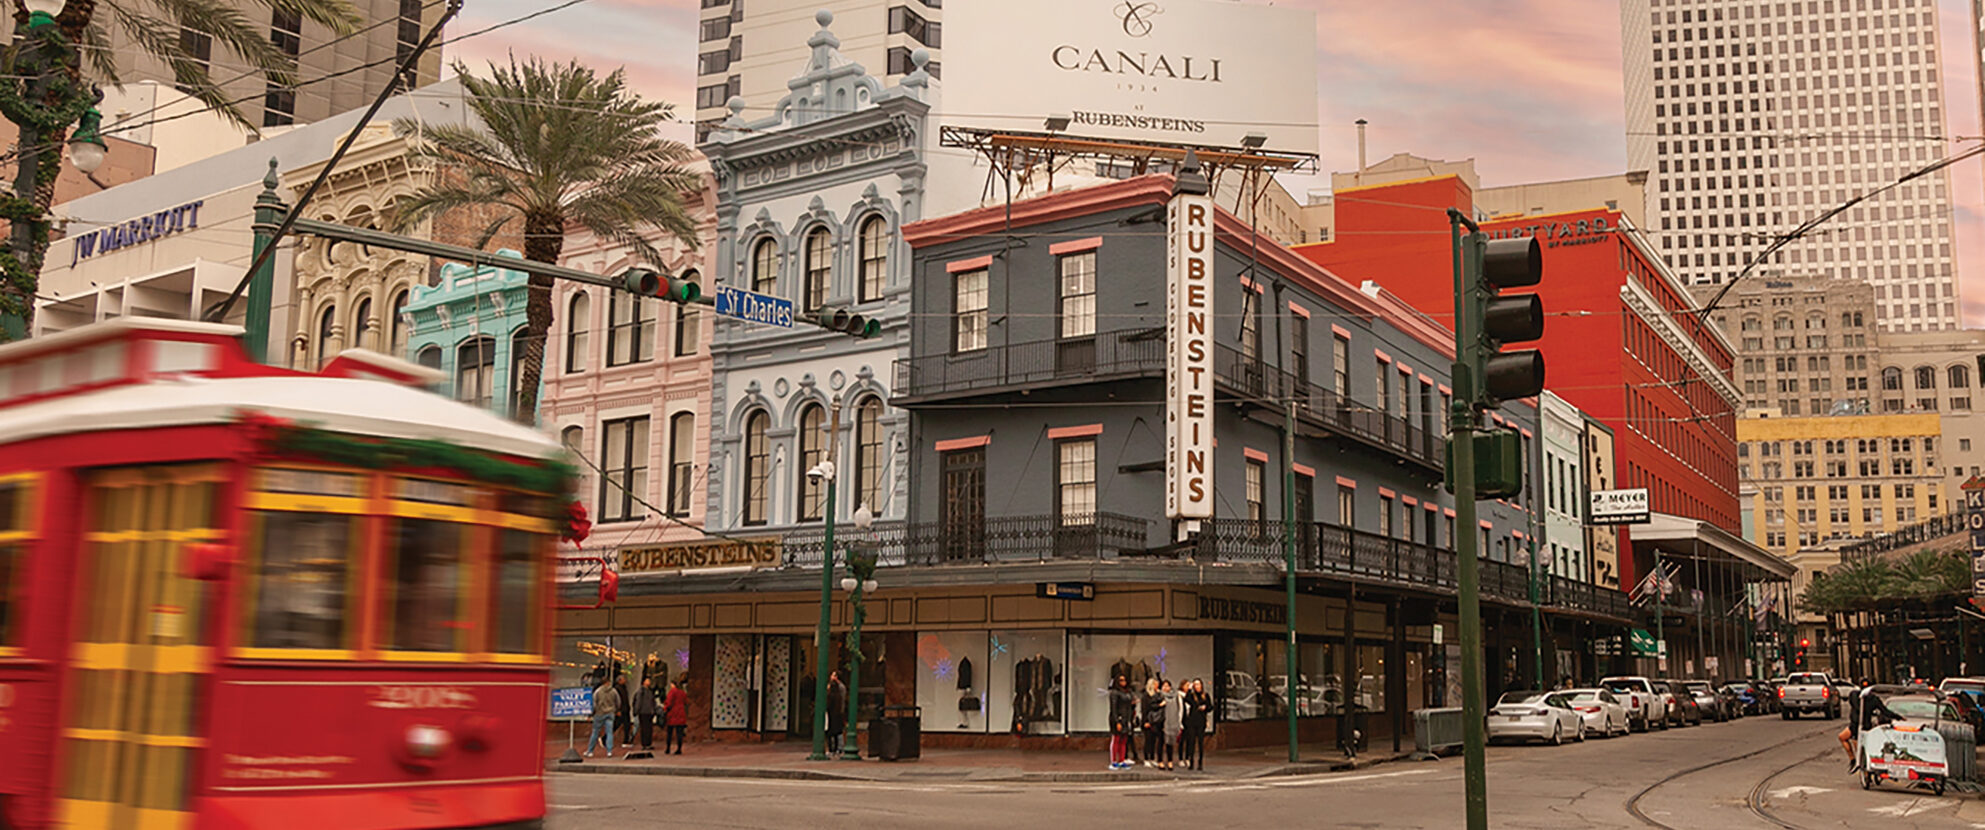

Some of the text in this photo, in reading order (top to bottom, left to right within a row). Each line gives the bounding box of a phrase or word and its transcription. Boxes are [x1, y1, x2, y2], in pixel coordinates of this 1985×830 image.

[1052, 45, 1222, 82] CANALI
[1072, 110, 1205, 133] RUBENSTEINS
[70, 200, 204, 269] JW MARRIOTT
[1480, 217, 1608, 241] OURTYARD
[725, 289, 791, 327] St Charles
[1187, 203, 1206, 503] RUBENSTEINS
[1609, 492, 1646, 504] MEYER
[622, 540, 776, 570] RUBENSTEINS
[1199, 596, 1288, 625] RUBENSTEIN
[554, 699, 592, 709] PARKING
[560, 690, 584, 700] VALET
